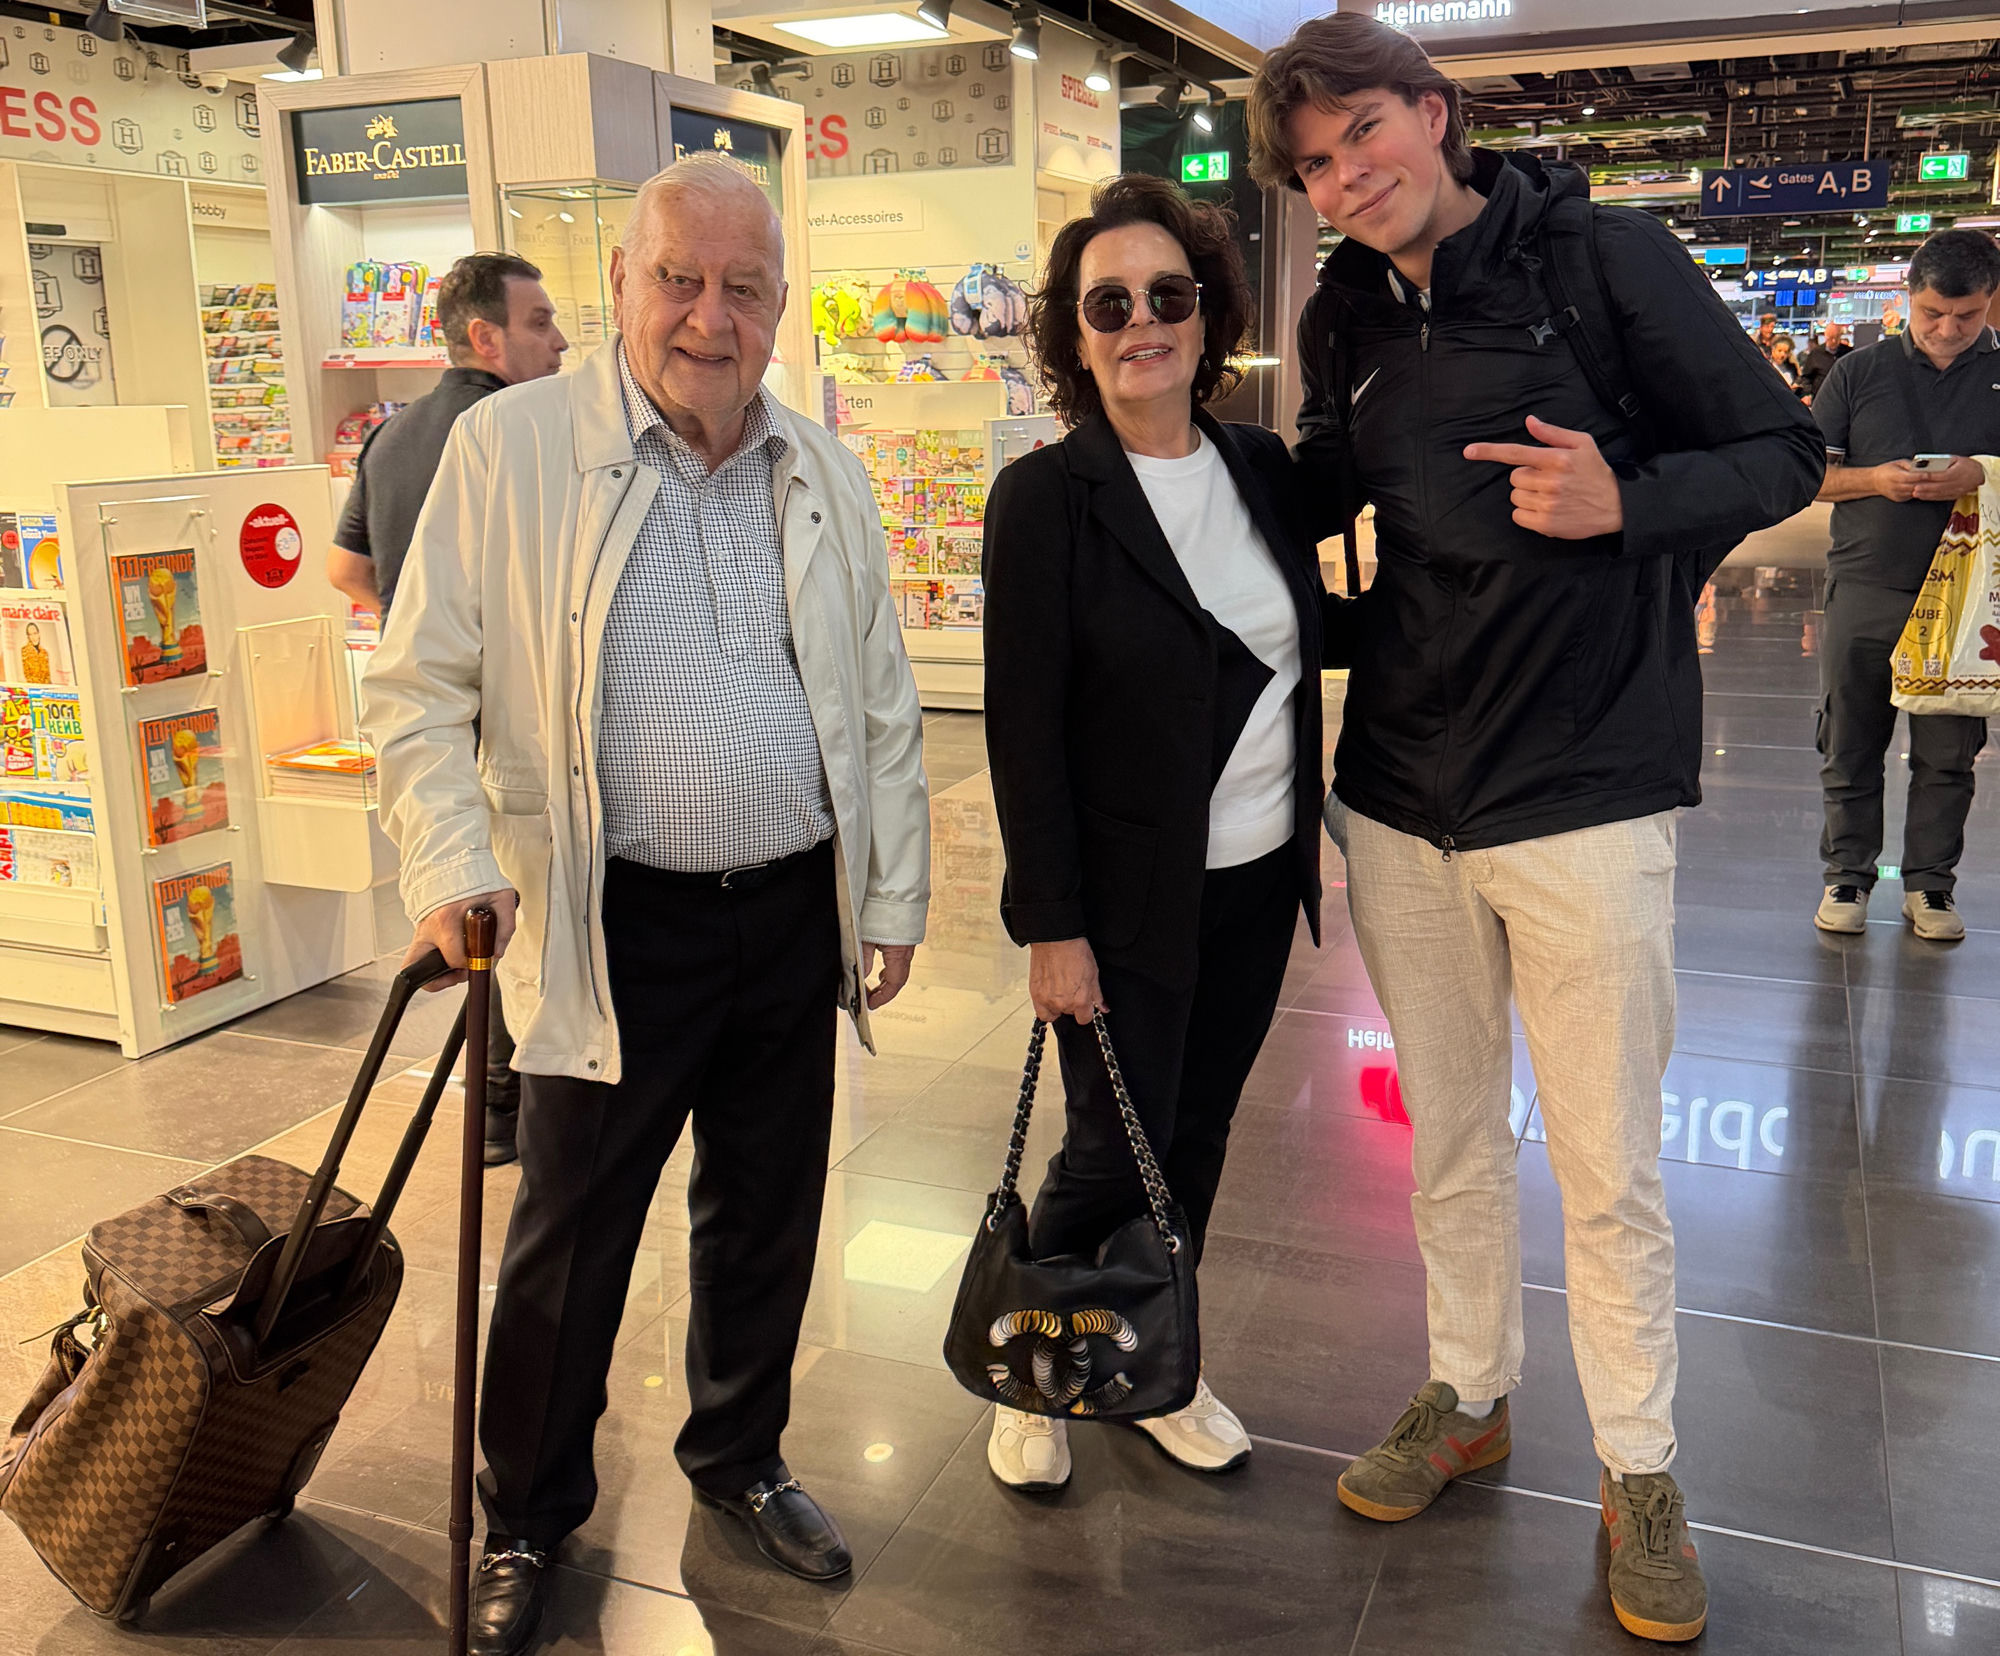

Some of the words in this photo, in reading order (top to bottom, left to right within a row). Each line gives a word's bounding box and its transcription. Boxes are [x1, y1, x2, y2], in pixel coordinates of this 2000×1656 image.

[1376, 0, 1512, 25] Heinemann
[303, 140, 467, 176] FABER-CASTELL
[1778, 173, 1815, 186] Gates
[193, 202, 227, 220] Hobby
[65, 346, 102, 361] ONLY
[1926, 568, 1956, 583] SM
[1919, 625, 1928, 637] 2
